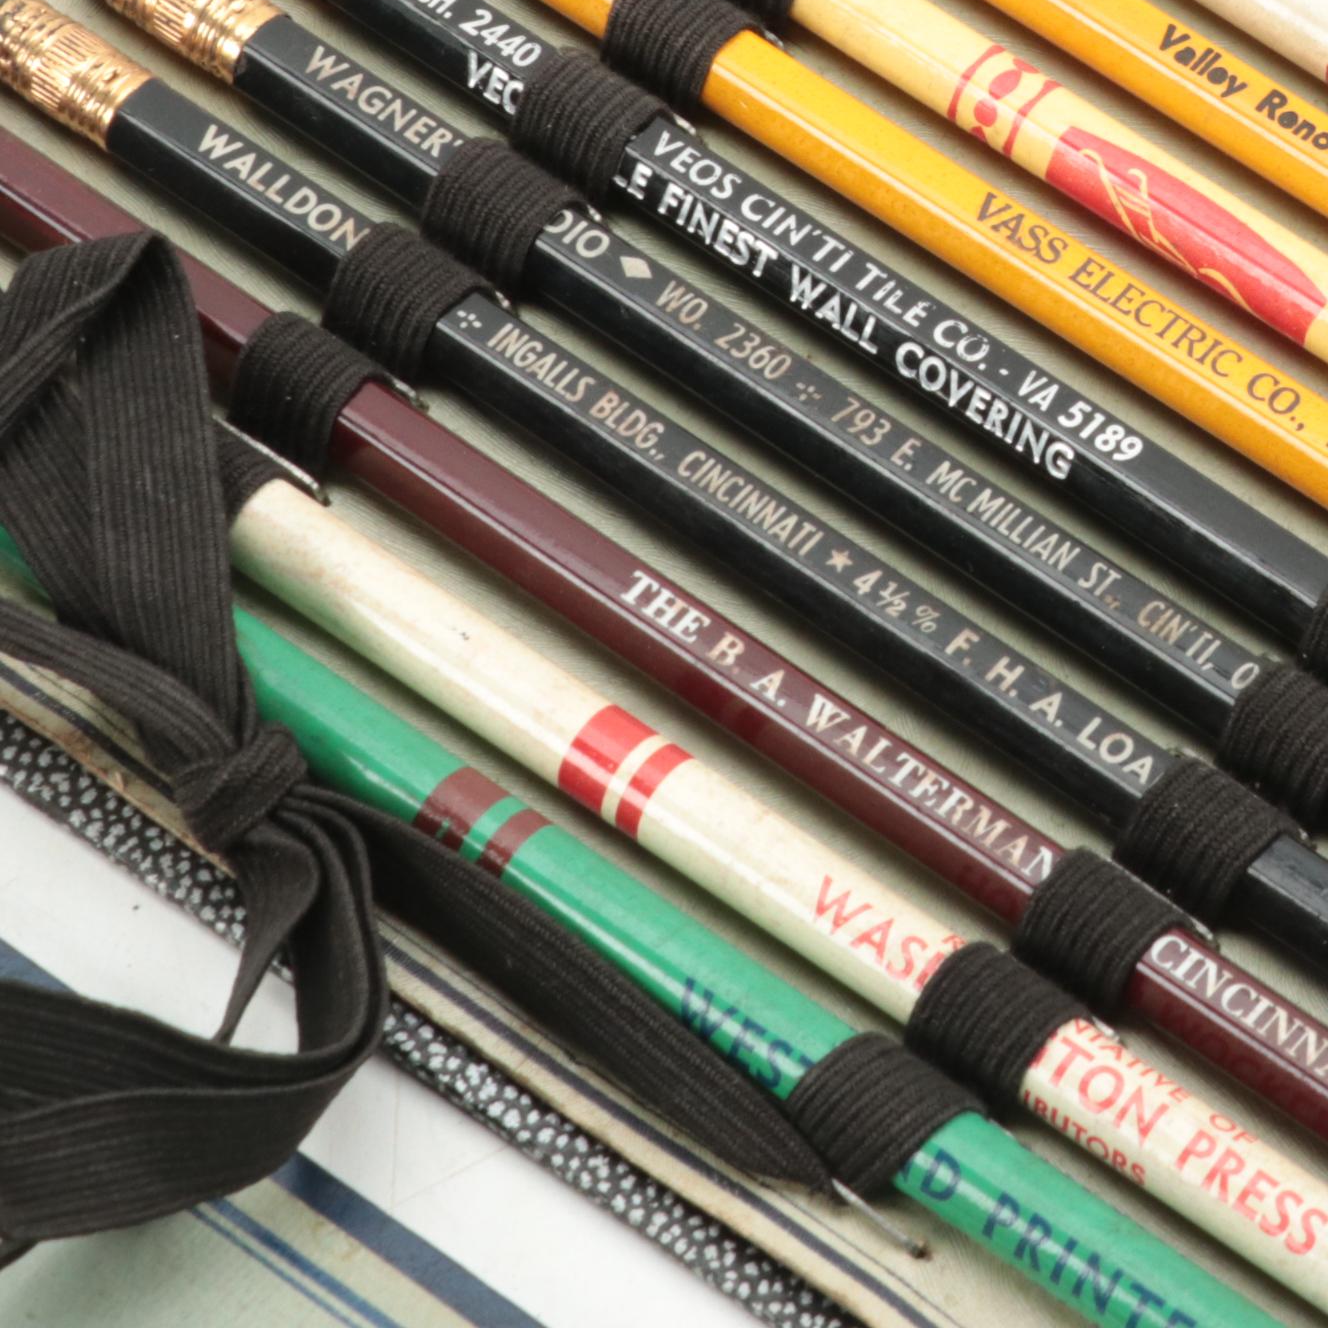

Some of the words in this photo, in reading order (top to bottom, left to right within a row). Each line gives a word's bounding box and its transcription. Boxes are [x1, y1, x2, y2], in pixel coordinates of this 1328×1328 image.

[458, 8, 543, 67] 2440
[1158, 23, 1248, 99] Valley
[304, 44, 465, 158] WAGNER'
[543, 209, 610, 259] DIO
[655, 279, 709, 331] WO.
[713, 322, 793, 380] 2360
[830, 396, 892, 446] 793
[889, 437, 923, 471] E.
[653, 130, 743, 200] VEOS
[854, 261, 929, 328] TILE
[932, 319, 990, 371] CO.
[1017, 370, 1060, 412] VA
[1057, 400, 1144, 461] 5189
[656, 182, 779, 278] FINEST
[789, 263, 879, 356] WALL
[894, 341, 1075, 481] COVERING
[974, 191, 1069, 265] VASS
[1068, 255, 1244, 379] ELECTRIC
[1246, 372, 1305, 432] CO.,
[197, 123, 371, 251] WALLDON
[486, 322, 596, 404] INGALLS
[676, 450, 825, 556] CINCINNATI
[944, 627, 980, 668] F.
[983, 655, 1025, 698] H.
[1027, 691, 1064, 728] A.
[1075, 716, 1158, 786] LOA
[618, 570, 712, 645] THE
[706, 632, 747, 675] B.
[749, 668, 787, 709] A.
[803, 692, 1057, 882] WALTERMAN
[981, 1191, 1197, 1328] PRINT
